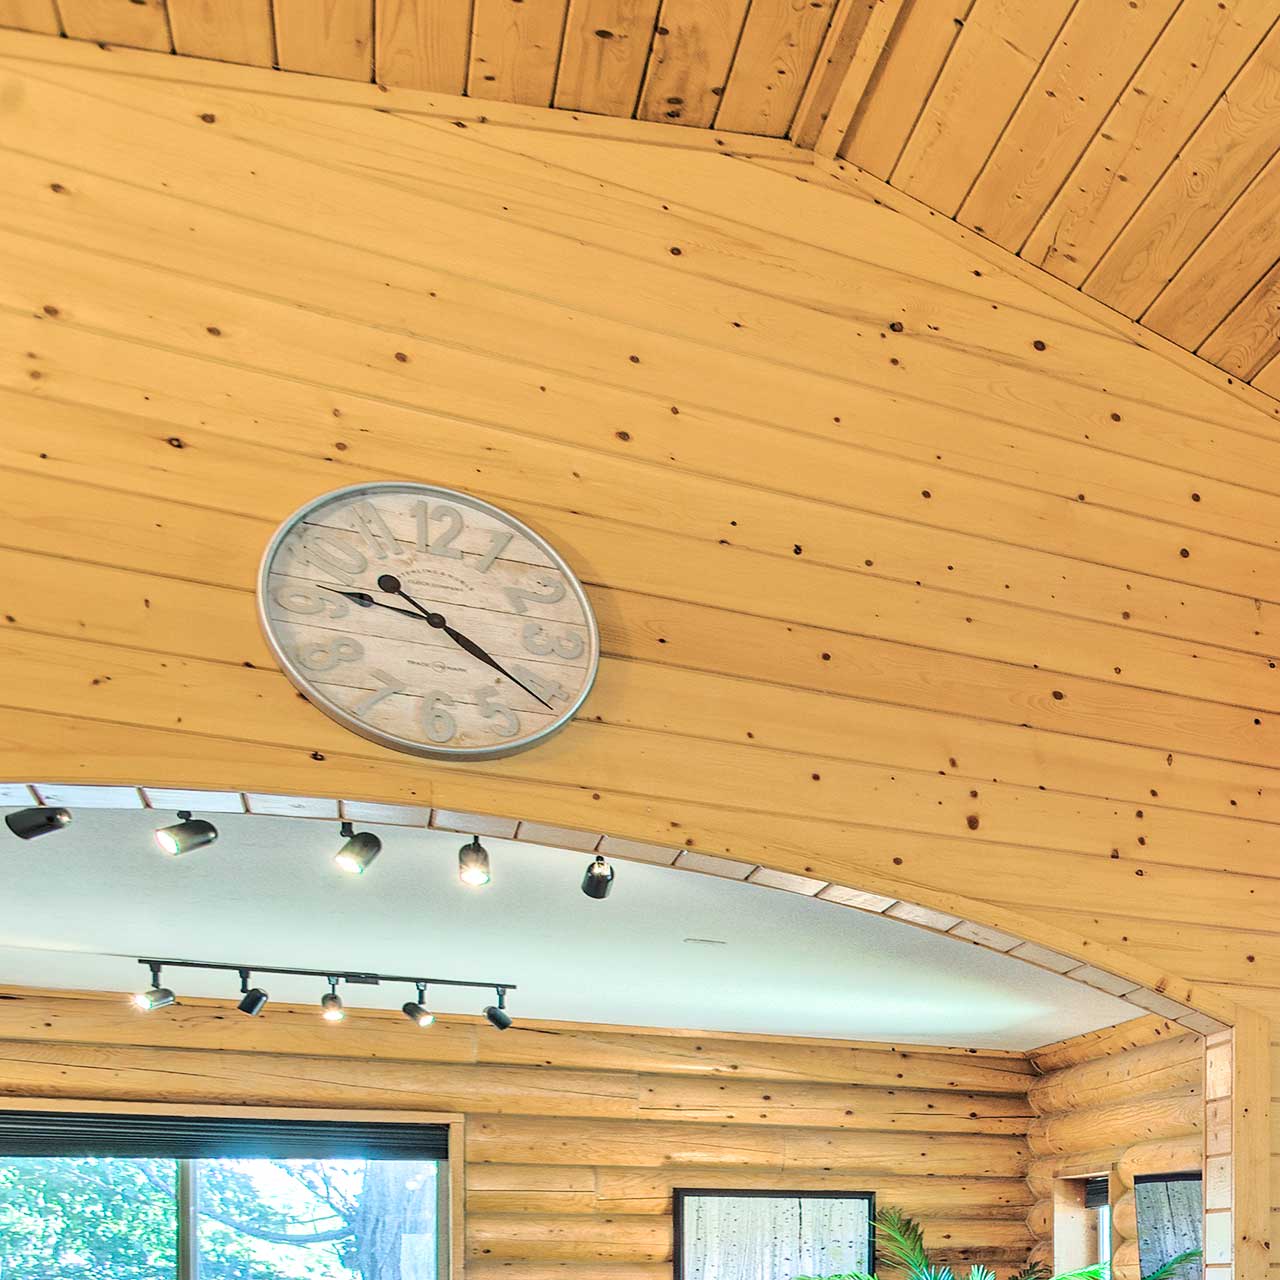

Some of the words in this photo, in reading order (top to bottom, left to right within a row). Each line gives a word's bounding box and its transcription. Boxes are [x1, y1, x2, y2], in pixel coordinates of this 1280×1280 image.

[348, 501, 403, 560] 11
[410, 500, 463, 559] 12
[476, 530, 514, 574] 1
[288, 529, 368, 586] 10
[276, 585, 350, 619] 9
[503, 575, 567, 614] 2
[297, 637, 365, 671] 8
[522, 622, 585, 660] 3
[355, 668, 406, 717] 7
[510, 664, 570, 704] 4
[420, 690, 457, 743] 6
[474, 685, 521, 737] 5
